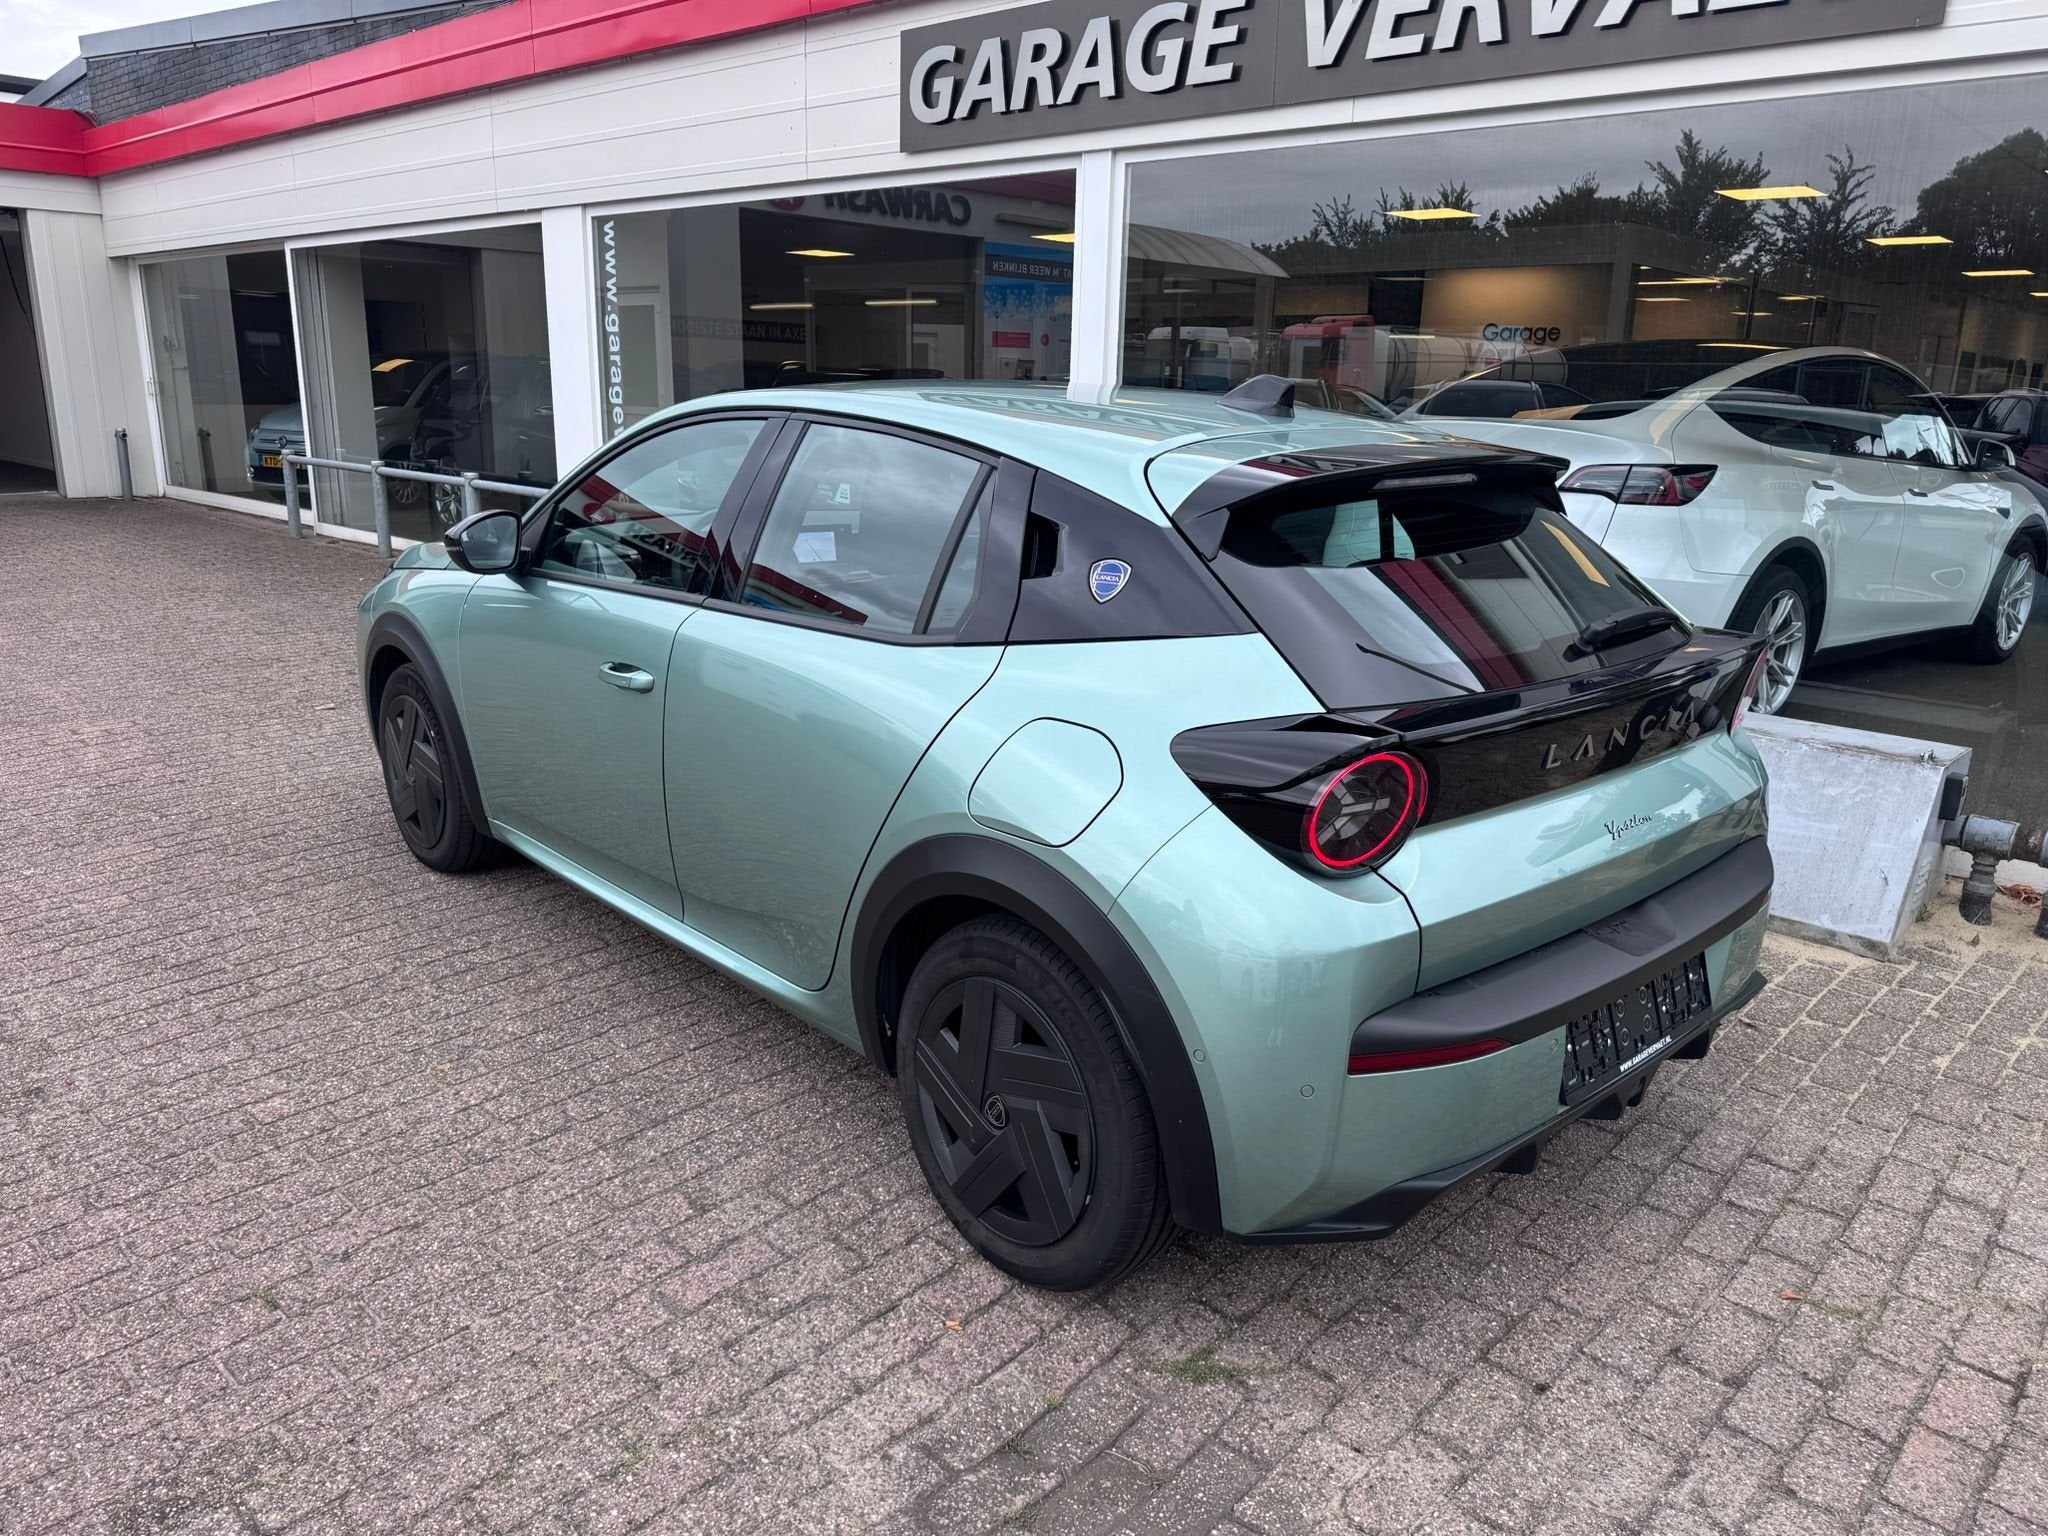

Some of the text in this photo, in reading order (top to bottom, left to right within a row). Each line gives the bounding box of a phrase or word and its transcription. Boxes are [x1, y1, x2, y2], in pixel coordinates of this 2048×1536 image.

[909, 0, 1246, 125] GARAGE
[1482, 322, 1561, 345] Garage
[1095, 574, 1120, 582] LANCIA
[1541, 701, 1696, 770] LANCIA
[1604, 814, 1653, 841] Ypsilon
